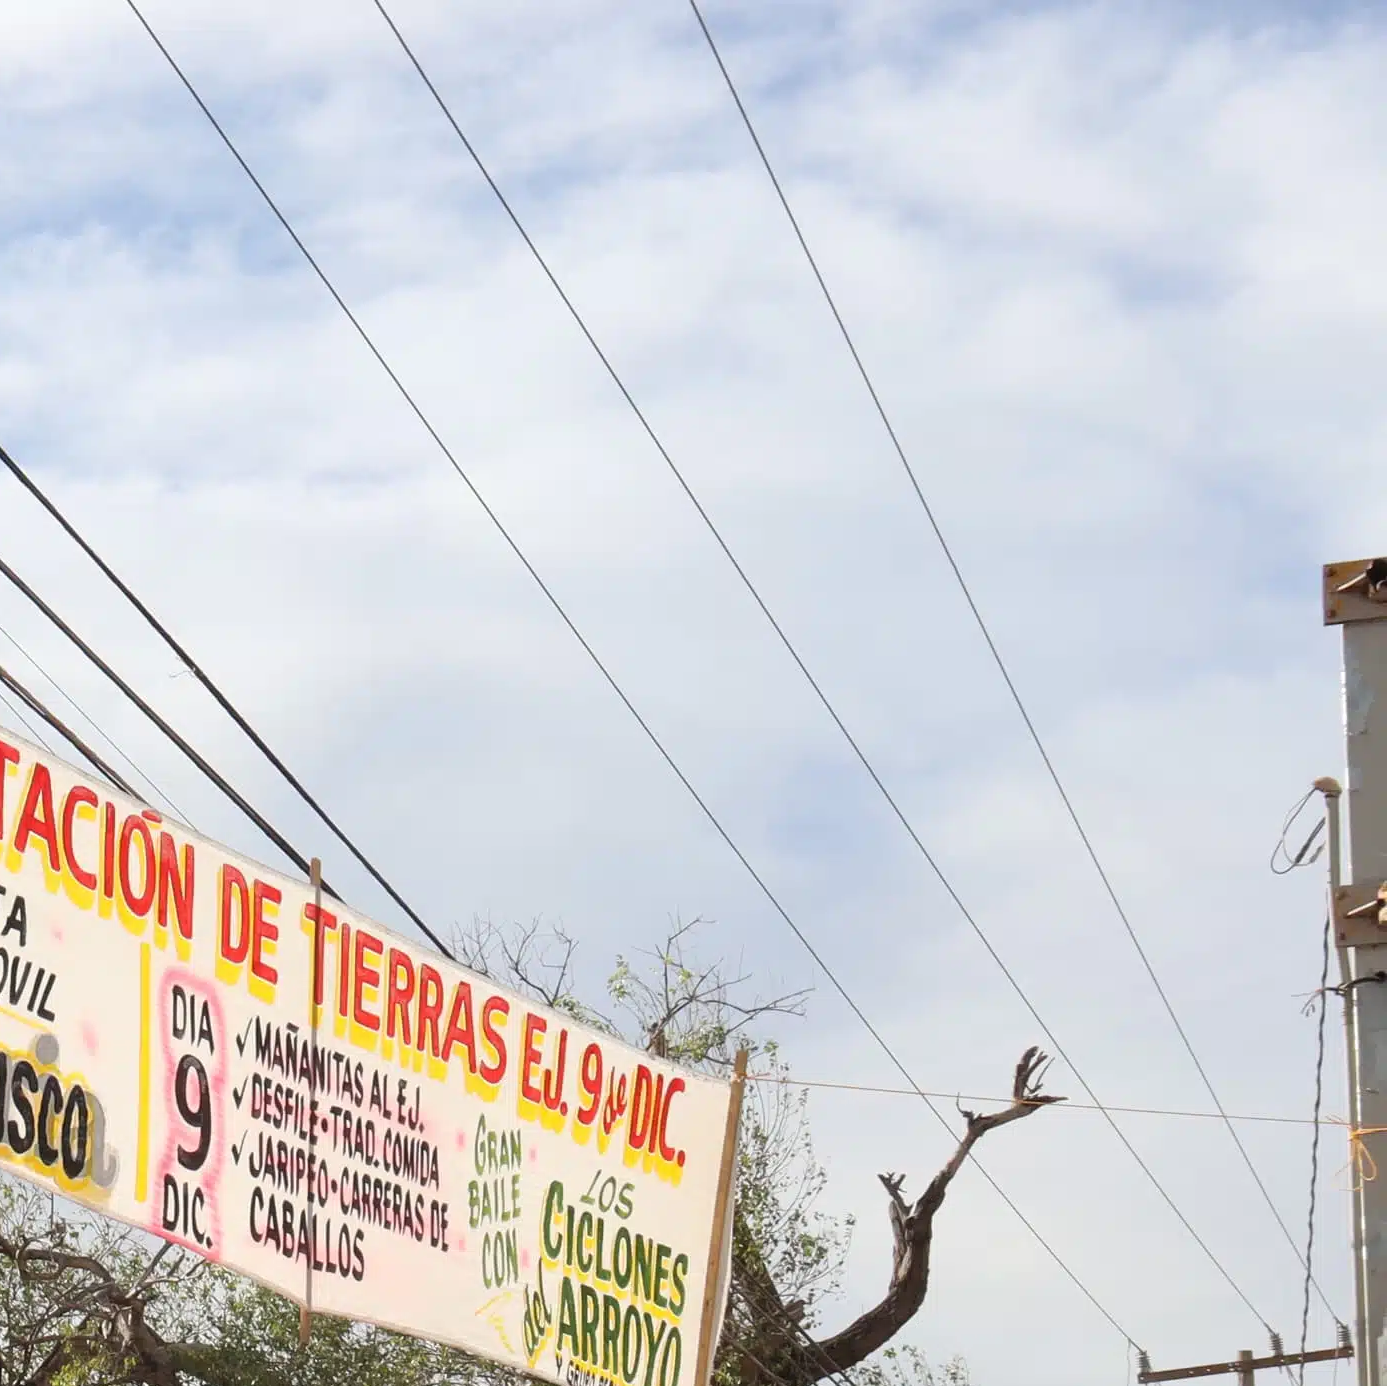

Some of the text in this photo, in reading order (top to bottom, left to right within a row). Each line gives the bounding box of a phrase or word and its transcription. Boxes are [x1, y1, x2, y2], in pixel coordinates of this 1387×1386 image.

[171, 984, 215, 1053] DIA
[220, 863, 281, 985] DE
[304, 903, 510, 1084] TIERRAS
[523, 1012, 569, 1116] EJ.
[580, 1044, 605, 1126] 9
[629, 1063, 687, 1167] DIC.
[175, 1055, 212, 1172] 9
[255, 1015, 426, 1133] MAÑANITAS AL EJ.
[251, 1072, 440, 1192] DESFILE TRAD. COMIDA
[474, 1113, 522, 1176] GRAN
[162, 1175, 214, 1251] DIC.
[249, 1131, 449, 1252] JARIPEO CARRERAS DE
[250, 1186, 365, 1281] CABALLOS
[468, 1174, 521, 1229] BAILE
[580, 1168, 636, 1220] LOS
[482, 1228, 519, 1289] CON
[543, 1180, 689, 1318] CICLONES
[523, 1256, 552, 1357] del
